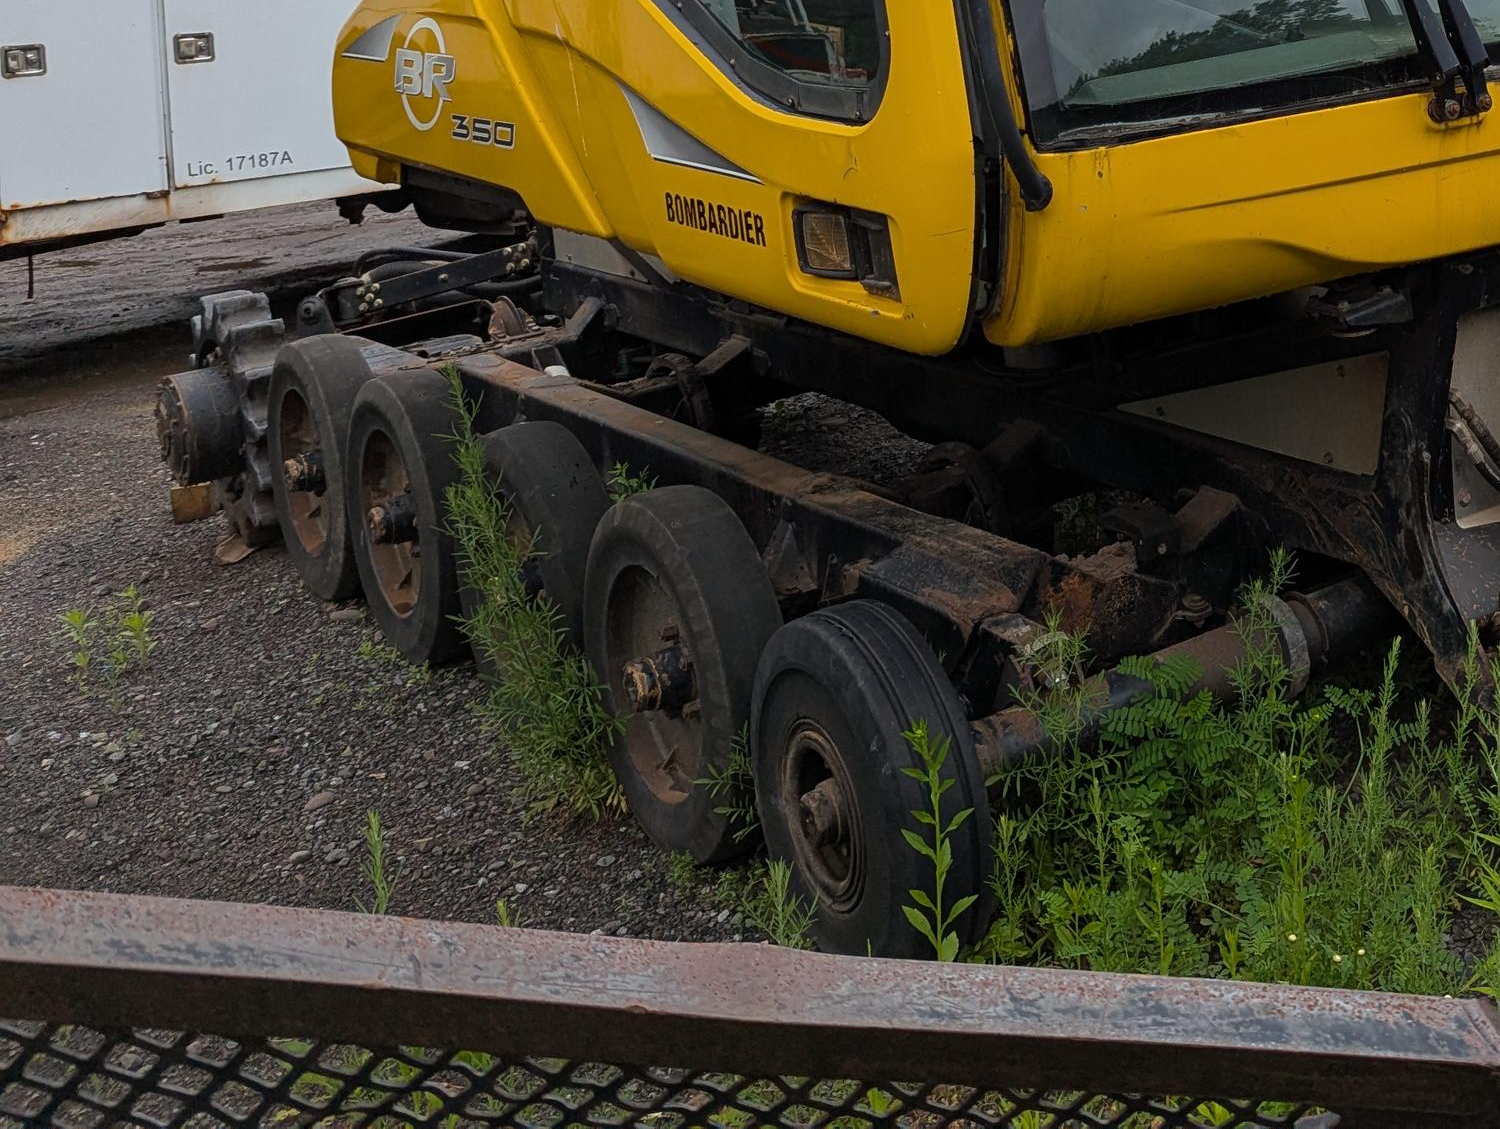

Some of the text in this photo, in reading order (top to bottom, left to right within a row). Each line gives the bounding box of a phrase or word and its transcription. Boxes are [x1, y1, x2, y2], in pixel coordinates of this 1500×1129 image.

[395, 48, 456, 102] BR
[451, 114, 516, 150] 350
[187, 150, 293, 176] Lic. 17187A
[665, 191, 767, 247] BOMBARDIER
